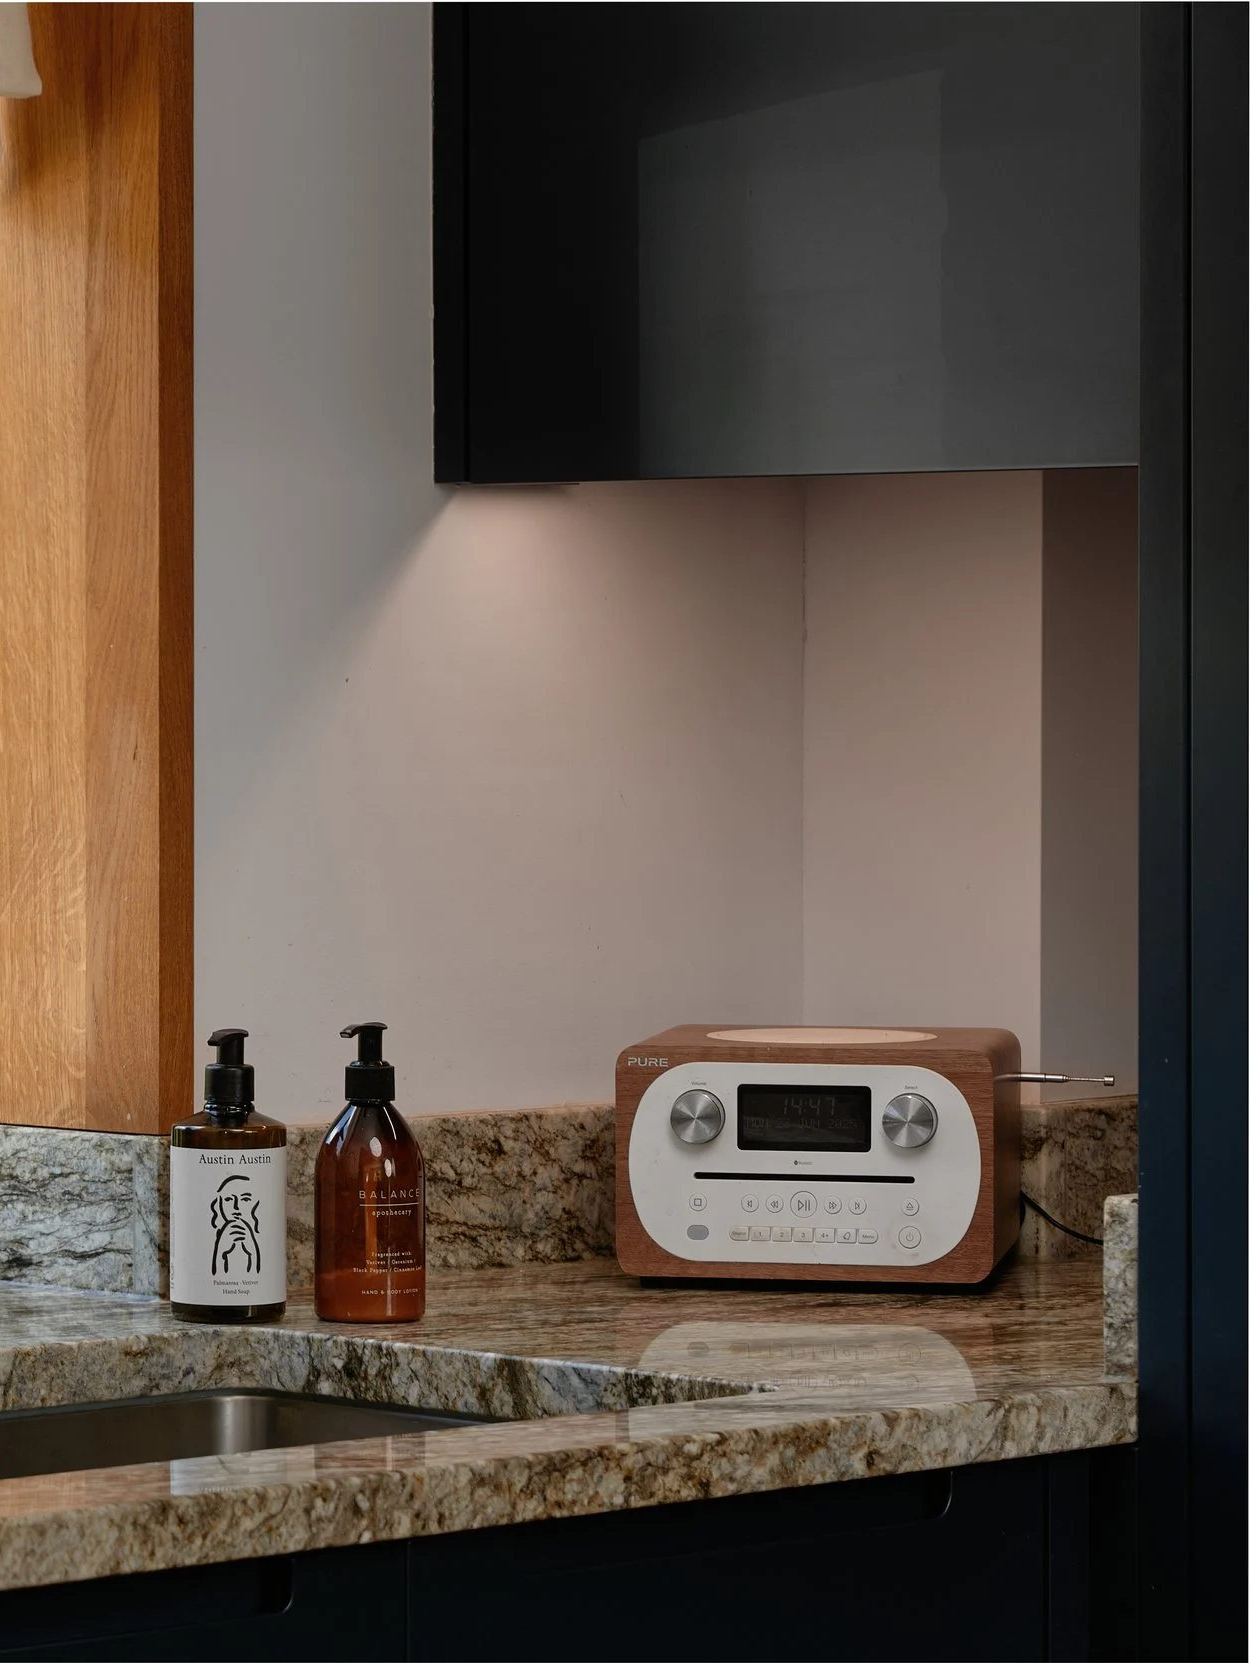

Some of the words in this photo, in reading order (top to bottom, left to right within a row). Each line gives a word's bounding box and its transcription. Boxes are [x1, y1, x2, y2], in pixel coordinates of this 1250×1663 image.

[627, 1057, 669, 1067] PURE
[783, 1096, 836, 1116] 14:47
[198, 1153, 234, 1164] Austin
[238, 1153, 271, 1164] Austin
[358, 1188, 420, 1199] BALANCE
[372, 1208, 412, 1218] apothecary
[238, 1288, 250, 1296] Soap
